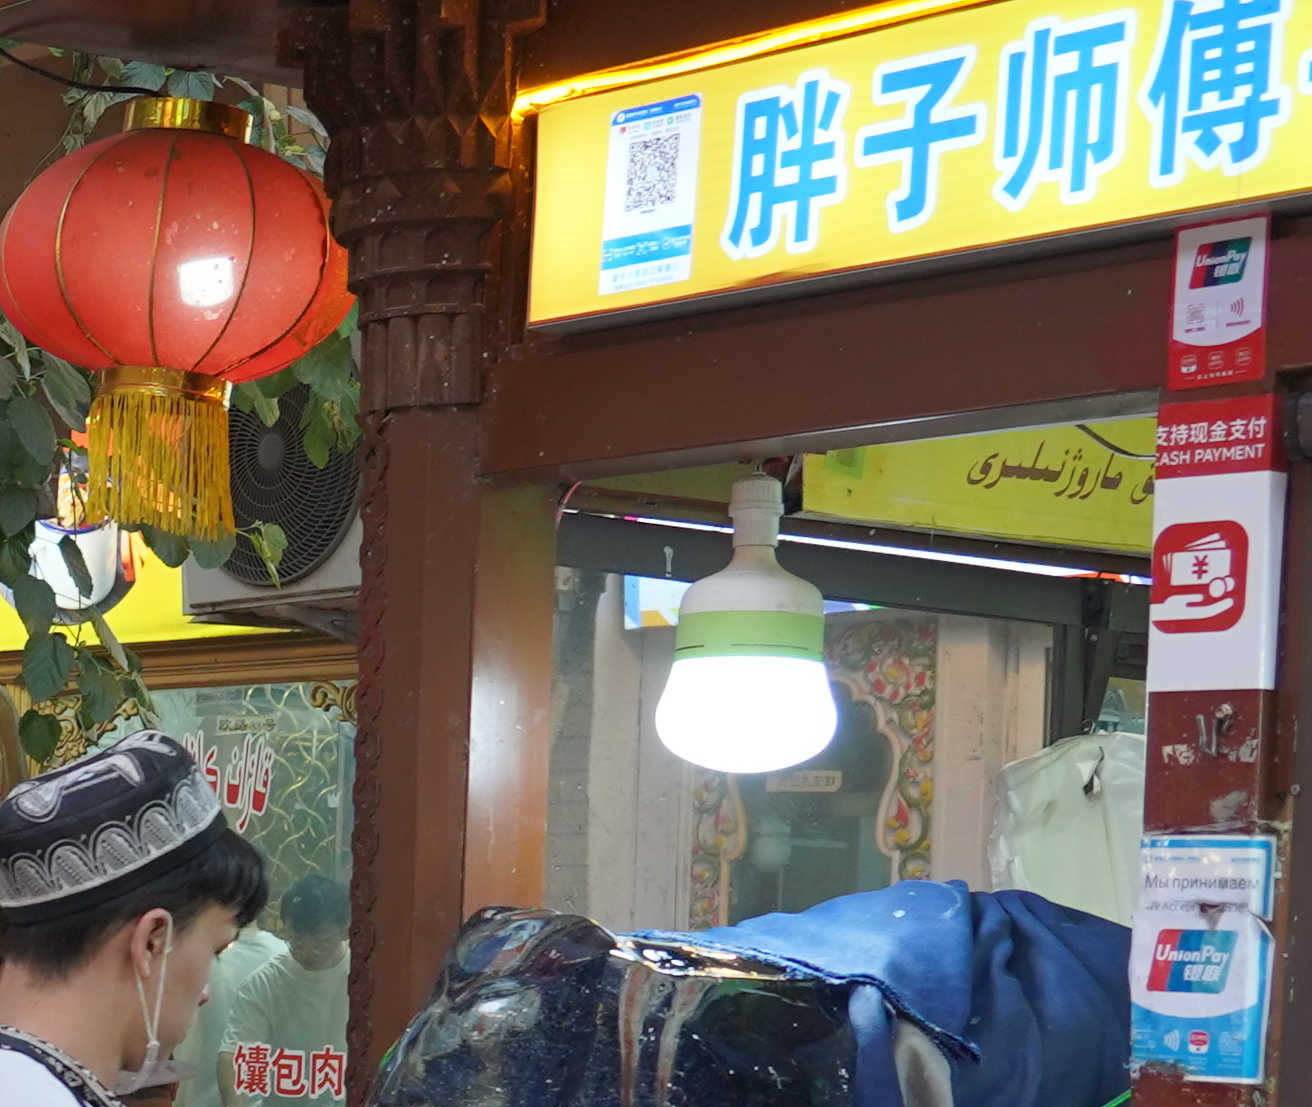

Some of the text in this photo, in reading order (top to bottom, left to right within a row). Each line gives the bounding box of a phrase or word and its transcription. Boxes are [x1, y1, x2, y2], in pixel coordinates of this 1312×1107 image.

[728, 0, 1312, 250] 胖子师傅
[1196, 250, 1247, 267] UnionPay
[1156, 416, 1266, 448] 支持现金支付
[1194, 443, 1266, 463] PAYMENT
[1156, 944, 1230, 964] UnionPay
[1183, 965, 1222, 982] 银联
[234, 1043, 346, 1097] 馕包肉
